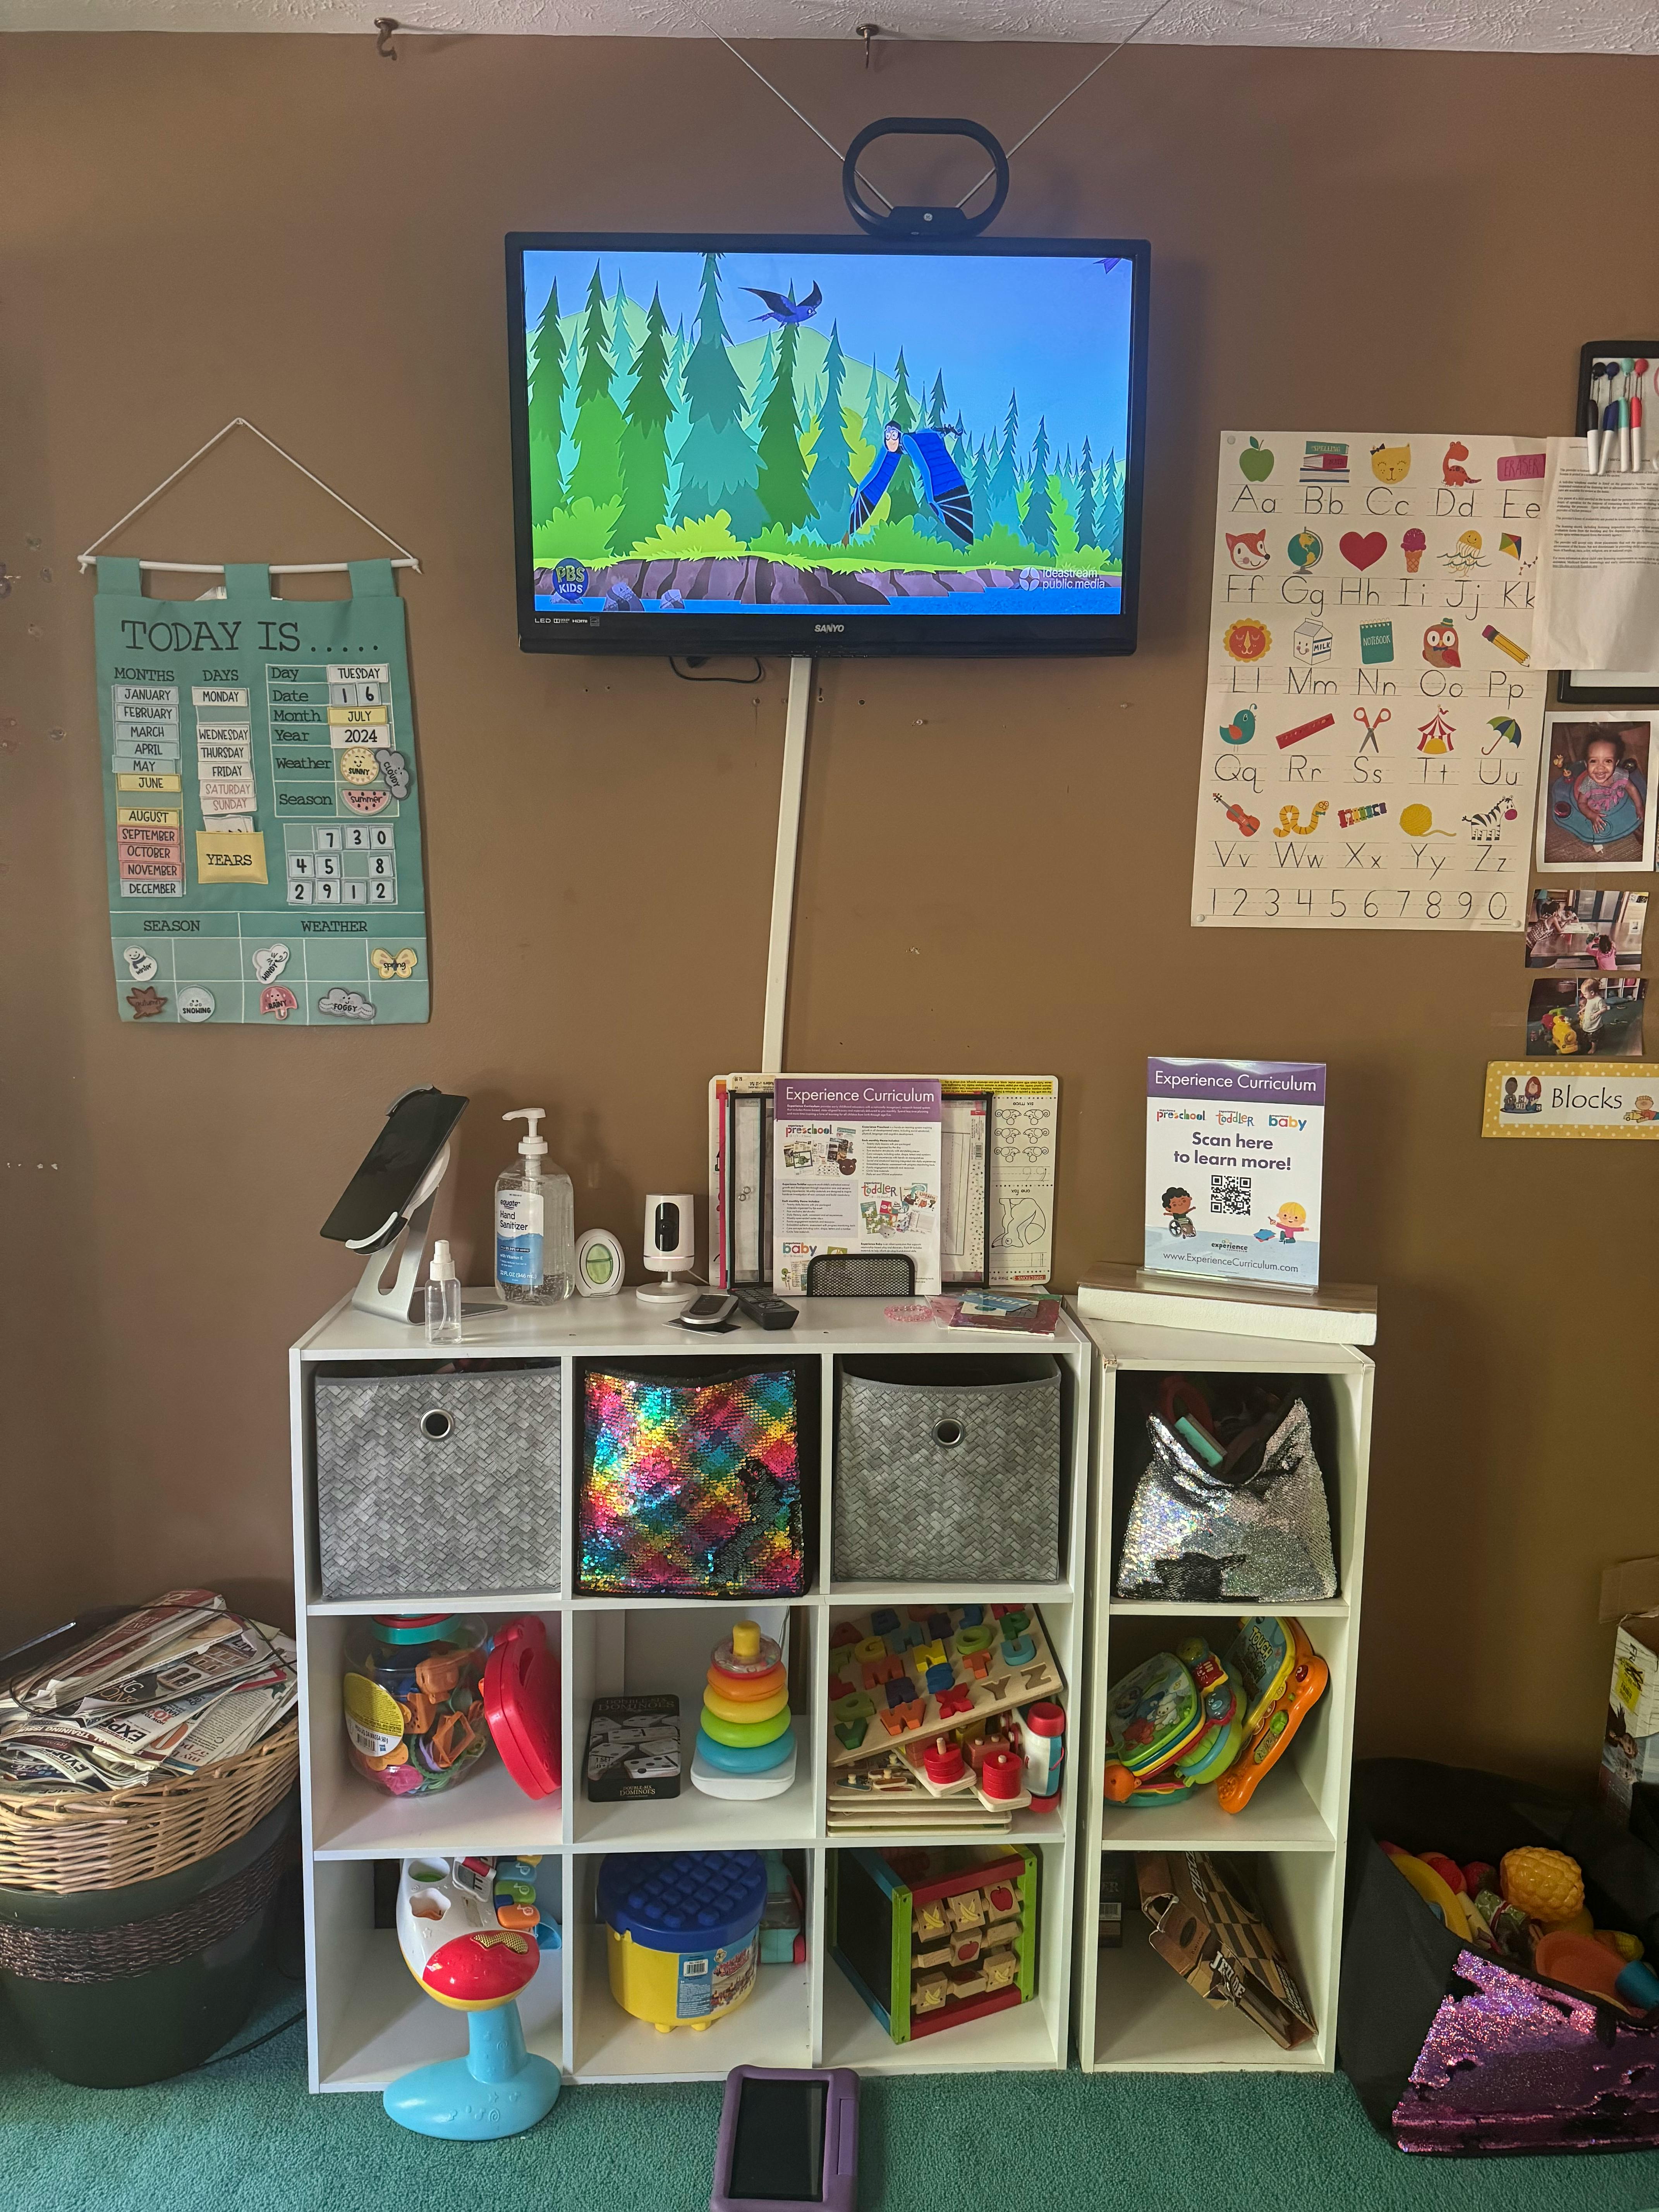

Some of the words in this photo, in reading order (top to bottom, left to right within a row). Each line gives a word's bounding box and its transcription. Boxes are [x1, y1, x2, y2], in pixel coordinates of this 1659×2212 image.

[1504, 458, 1539, 477] ERASER
[1231, 485, 1276, 513] Aa
[1305, 486, 1343, 514] Bb
[1366, 487, 1408, 515] Cc
[1436, 488, 1474, 517] Dd
[1503, 490, 1540, 519] Ee
[556, 565, 586, 583] PBS
[1043, 567, 1098, 578] ideastream
[559, 583, 583, 594] KIDS
[1043, 579, 1071, 590] public
[1073, 579, 1105, 589] media
[1282, 576, 1324, 617] Gg
[1340, 577, 1379, 605] Hh
[814, 624, 845, 634] SANYO
[121, 620, 241, 652] TODAY
[1363, 635, 1391, 647] NOTEBOOK
[1314, 641, 1331, 652] MILK
[114, 668, 175, 682] MONTHS
[203, 670, 239, 682] DAYS
[271, 667, 299, 681] Day
[338, 668, 381, 680] TUESDAY
[125, 689, 172, 701] JANUARY
[273, 690, 309, 702] Date
[343, 689, 347, 703] 1
[366, 686, 374, 701] 6
[1289, 670, 1337, 695] Mm
[1358, 669, 1395, 696] Nn
[1420, 670, 1463, 697] Oo
[1489, 672, 1523, 709] Pp
[203, 691, 239, 703] MONDAY
[124, 708, 172, 720] FEBRUARY
[274, 710, 322, 723] Month
[348, 711, 371, 723] JULY
[131, 726, 165, 738] MARCH
[199, 729, 248, 741] WEDNESDAY
[276, 730, 309, 742] Year
[345, 730, 378, 743] 2024
[135, 743, 163, 756] APRIL
[202, 747, 244, 759] THURSDAY
[133, 761, 155, 772] MAY
[213, 766, 242, 778] FRIDAY
[276, 757, 332, 769] Weather
[349, 768, 370, 776] SUNNY
[383, 762, 400, 788] CLOUDY
[1214, 754, 1264, 794] Qq
[1288, 755, 1322, 782] Rr
[1353, 756, 1382, 783] Ss
[1417, 758, 1448, 784] Tt
[1479, 759, 1518, 785] Uu
[139, 778, 163, 789] JUNE
[206, 783, 251, 795] SATURDAY
[213, 799, 247, 810] SUNDAY
[279, 794, 333, 805] Season
[350, 795, 383, 804] summer
[129, 811, 169, 823] AUGUST
[122, 830, 175, 842] SEPTEMBER
[326, 833, 334, 847] 7
[354, 830, 361, 845] 3
[378, 831, 385, 845] 0
[127, 846, 170, 859] OCTOBER
[206, 854, 252, 866] YEARS
[297, 859, 307, 873] 4
[325, 859, 332, 874] 5
[376, 858, 384, 873] 8
[128, 864, 177, 876] NOVEMBER
[129, 883, 176, 895] DECEMBER
[295, 884, 304, 899] 2
[324, 883, 331, 898] 9
[352, 885, 356, 899] 1
[376, 884, 385, 898] 2
[1233, 889, 1248, 915] 2
[1265, 890, 1279, 916] 3
[1298, 889, 1312, 915] 4
[1330, 890, 1346, 917] 5
[1364, 890, 1378, 917] 6
[1397, 890, 1410, 917] 7
[1427, 891, 1441, 918] 8
[1458, 892, 1472, 918] 9
[144, 921, 200, 932] SEASON
[301, 921, 368, 932] WEATHER
[136, 962, 152, 975] winter
[261, 962, 279, 981] WINDY
[383, 961, 406, 970] spring
[268, 1000, 287, 1009] RAINY
[333, 1003, 358, 1012] FOGGY
[1155, 1070, 1233, 1089] Experience
[1237, 1074, 1316, 1092] Curriculum
[787, 1087, 859, 1104] Experience
[864, 1088, 934, 1102] Curriculum
[1552, 1085, 1622, 1109] Blocks
[1269, 1115, 1307, 1131] baby
[786, 1124, 832, 1137] preschool
[1192, 1132, 1231, 1147] Scan
[1236, 1133, 1273, 1149] here
[1174, 1151, 1190, 1163] to
[1195, 1150, 1236, 1166] learn
[1242, 1158, 1291, 1170] more!
[500, 1211, 515, 1219] Hand
[500, 1220, 528, 1230] Sanitizer
[783, 1242, 816, 1256] baby
[1163, 1252, 1298, 1272] www.ExperienceCurriculum.com
[1249, 1625, 1273, 1661] TOUCH
[45, 1726, 89, 1738] TRAINING
